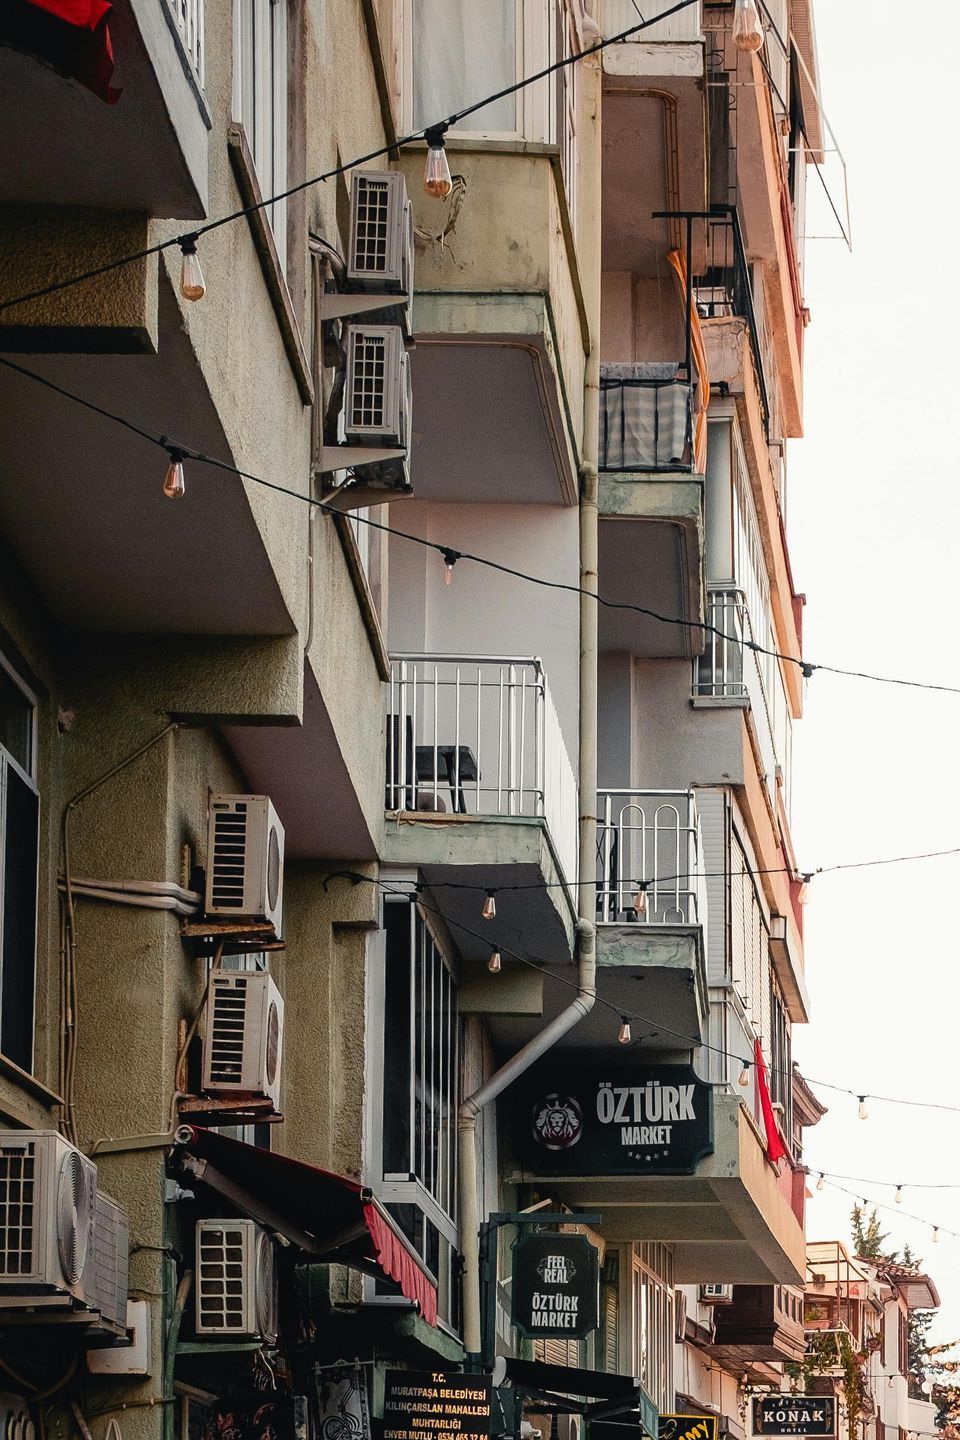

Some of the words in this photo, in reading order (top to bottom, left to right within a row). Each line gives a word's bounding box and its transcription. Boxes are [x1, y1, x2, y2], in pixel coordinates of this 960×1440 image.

[596, 1081, 696, 1124] ÖZTÜRK
[621, 1125, 672, 1146] MARKET
[547, 1255, 567, 1269] FEEL
[544, 1268, 569, 1284] REAL
[531, 1292, 579, 1311] ÖZTÜRK
[531, 1311, 578, 1328] MARKET
[432, 1373, 447, 1383] T.C.
[390, 1387, 438, 1399] MURATPAŞA
[440, 1388, 487, 1401] BELEDİYESİ
[385, 1401, 443, 1413] KILINÇARSLAN
[445, 1405, 490, 1417] MAHALLESİ
[763, 1410, 824, 1423] KONAK
[412, 1418, 461, 1429] MUHTARLIĞI
[384, 1430, 407, 1440] ENVER
[409, 1431, 433, 1440] MUTLU
